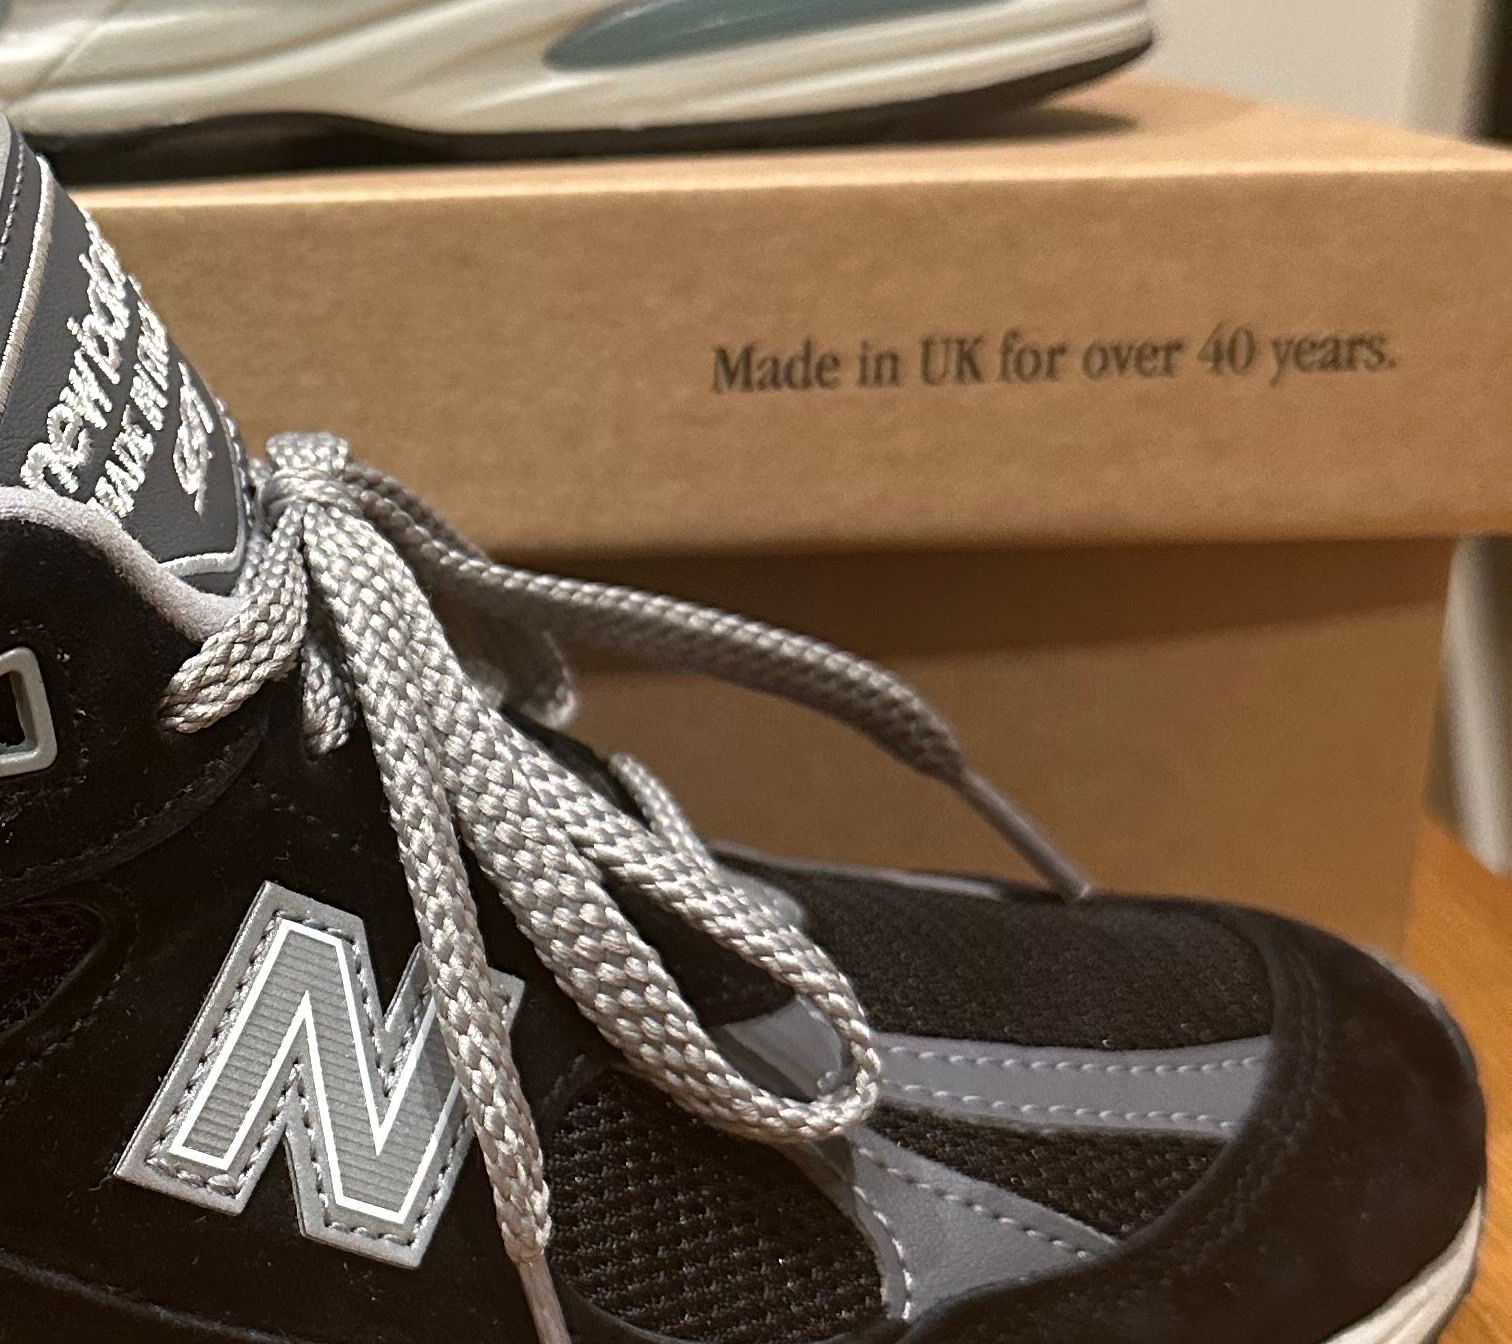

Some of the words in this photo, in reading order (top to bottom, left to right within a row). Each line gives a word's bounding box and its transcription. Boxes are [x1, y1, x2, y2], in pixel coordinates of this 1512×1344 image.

[20, 346, 114, 494] new
[712, 334, 840, 394] Made
[857, 339, 902, 389] in
[919, 333, 984, 386] UK
[998, 326, 1070, 384] for
[1081, 338, 1185, 380] over
[1197, 320, 1256, 376] 40
[1267, 331, 1397, 388] years.
[113, 880, 525, 1268] N
